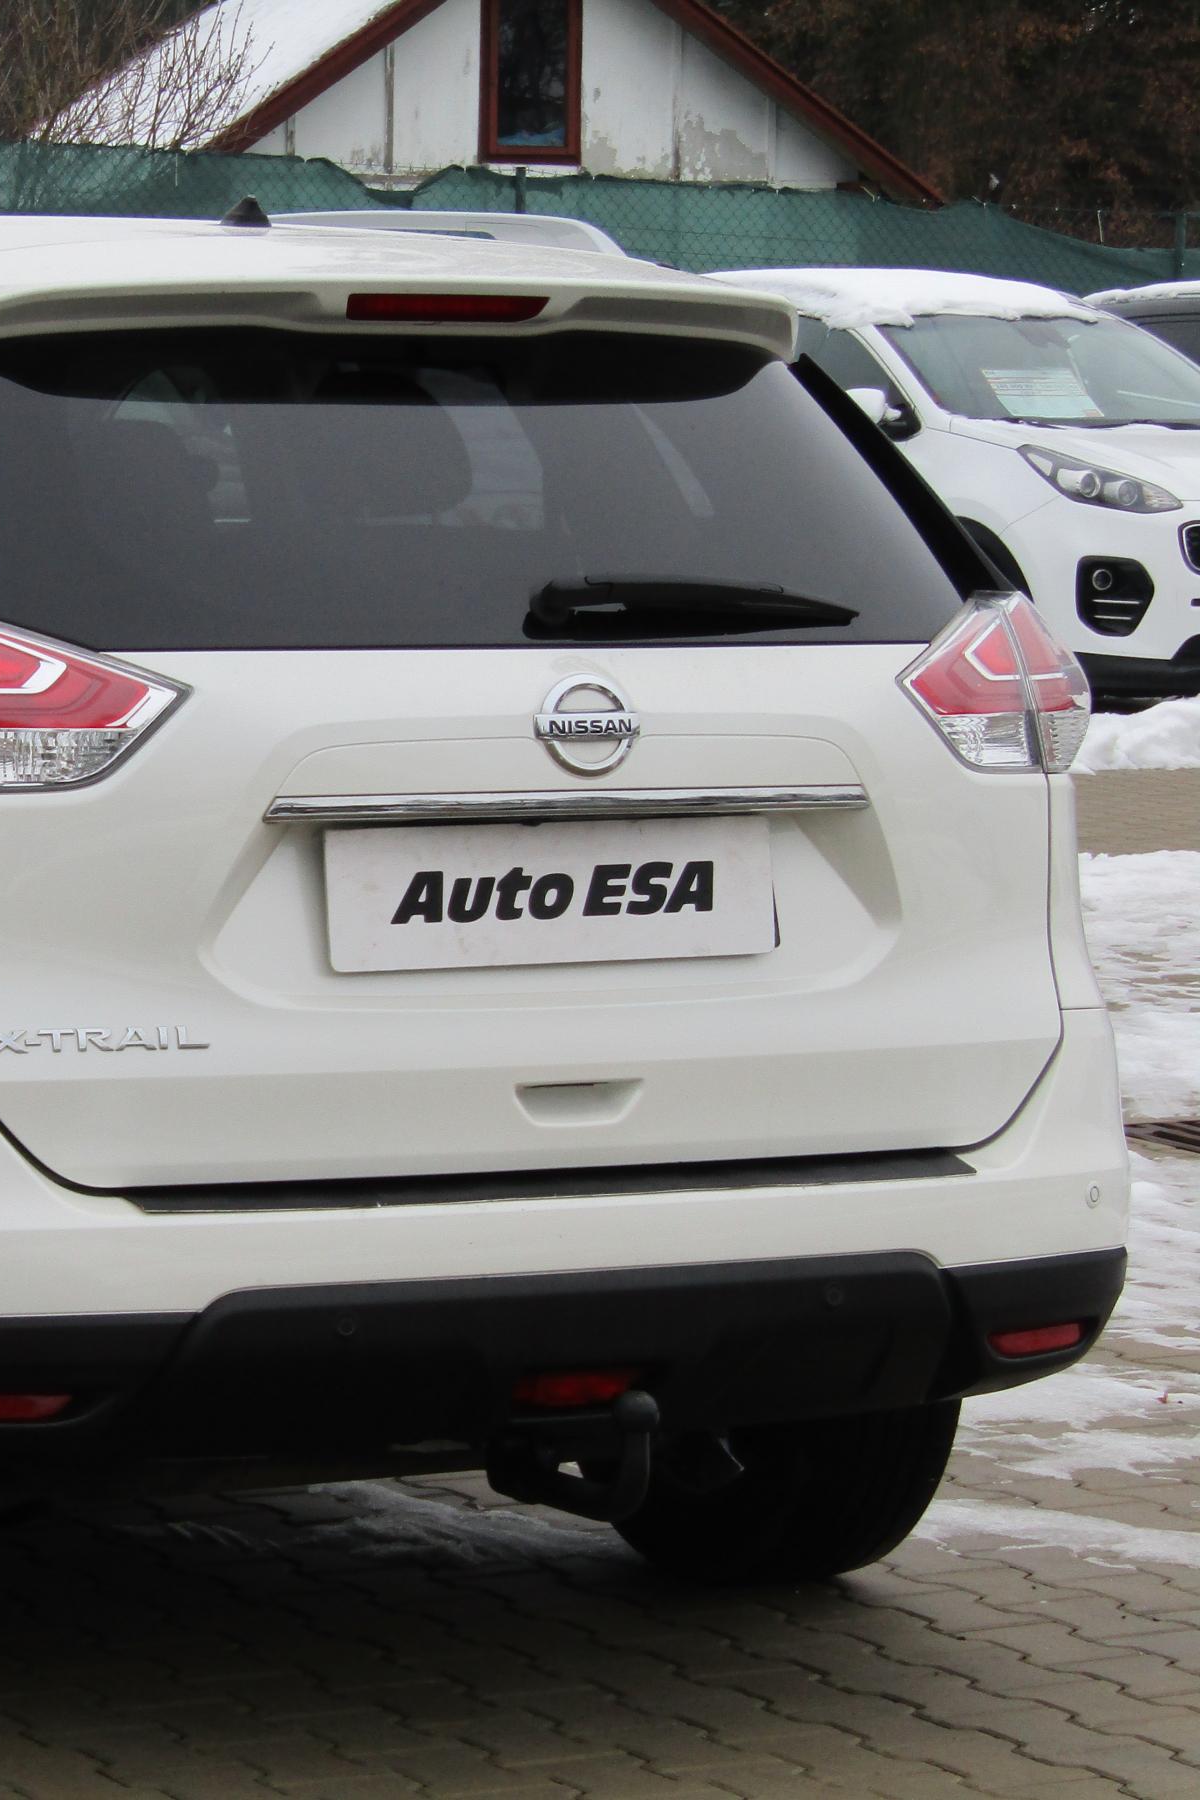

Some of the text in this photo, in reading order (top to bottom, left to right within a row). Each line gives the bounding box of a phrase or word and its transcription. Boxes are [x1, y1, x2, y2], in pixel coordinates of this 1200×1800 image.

[548, 718, 632, 735] NISSAN
[390, 860, 714, 925] Auto ESA
